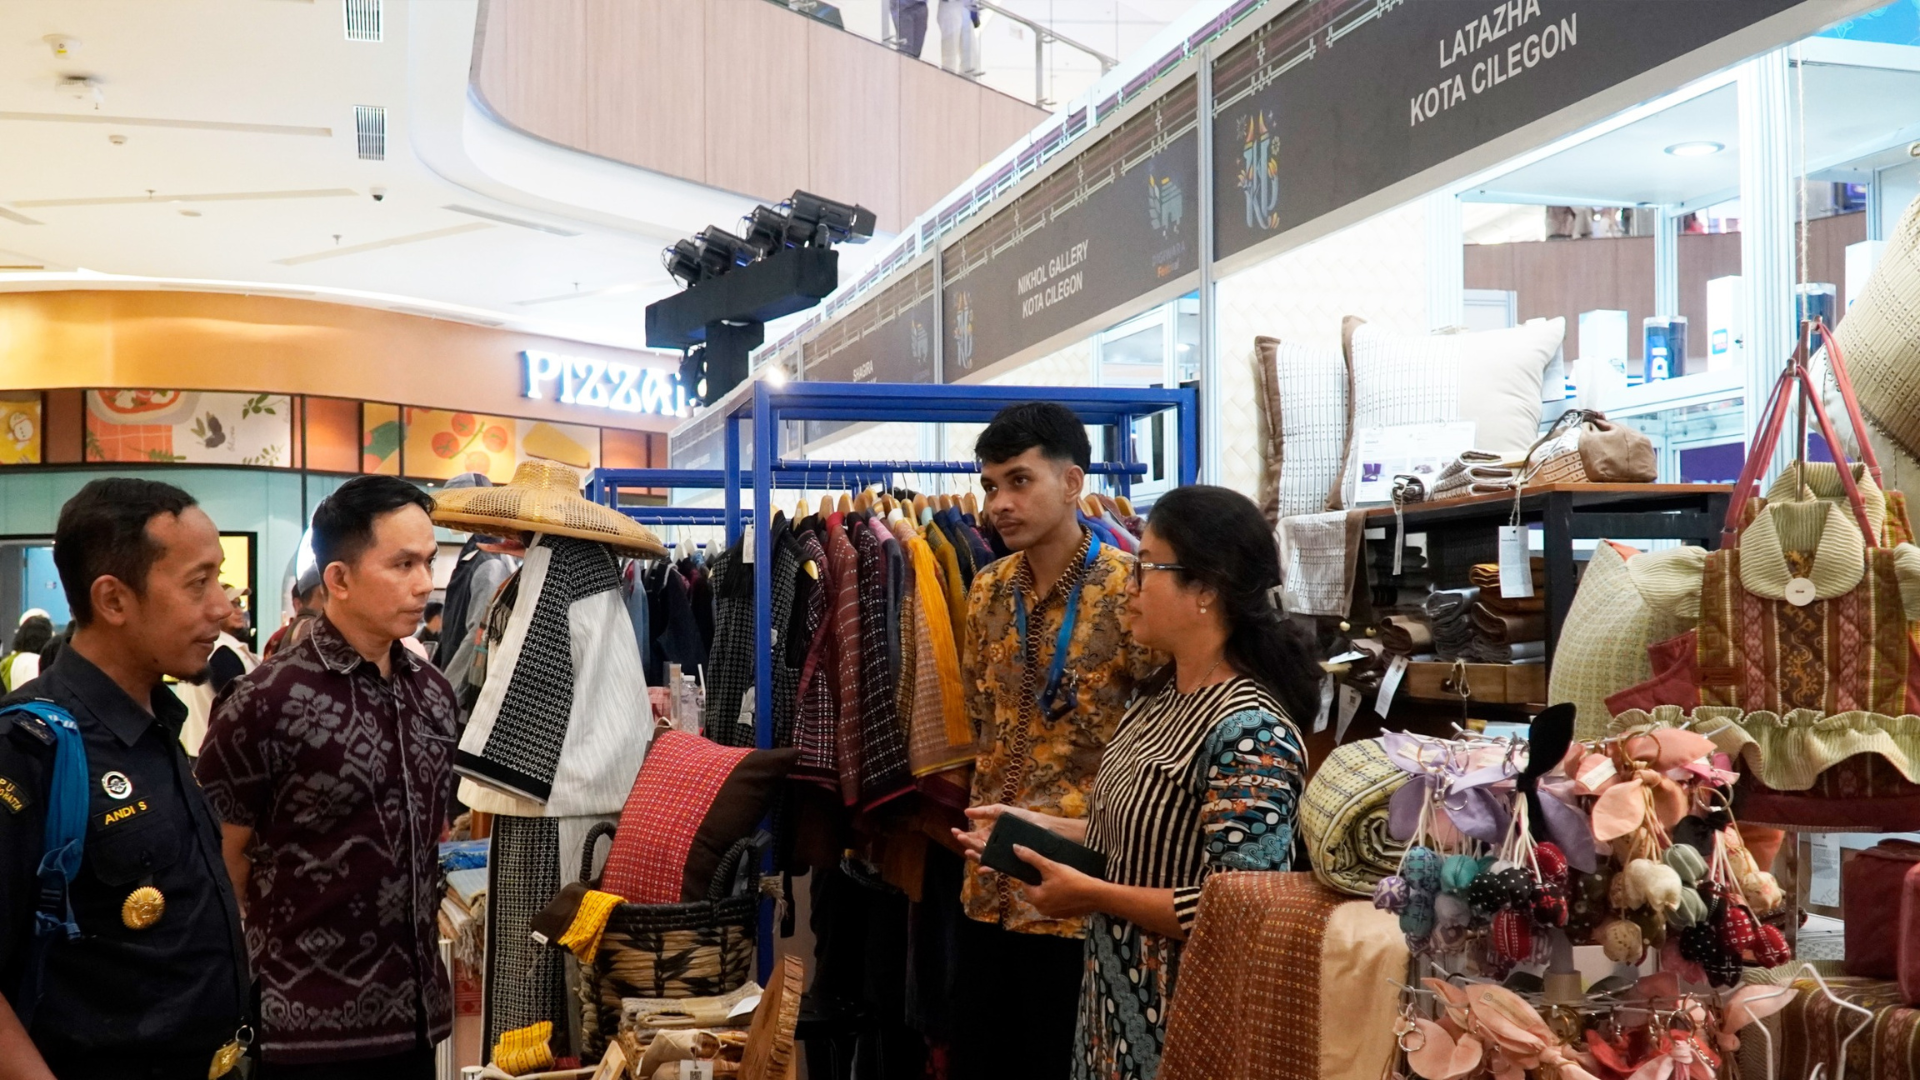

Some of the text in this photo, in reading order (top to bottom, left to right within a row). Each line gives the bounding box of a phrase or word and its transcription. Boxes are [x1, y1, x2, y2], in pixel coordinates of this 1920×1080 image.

[1439, 0, 1541, 68] LATAZHA
[1411, 12, 1577, 127] KOTA CILEGON
[1018, 239, 1089, 295] NIKHOL GALLERY
[1022, 270, 1083, 319] KOTA CILEGON
[105, 801, 147, 826] ANDI S
